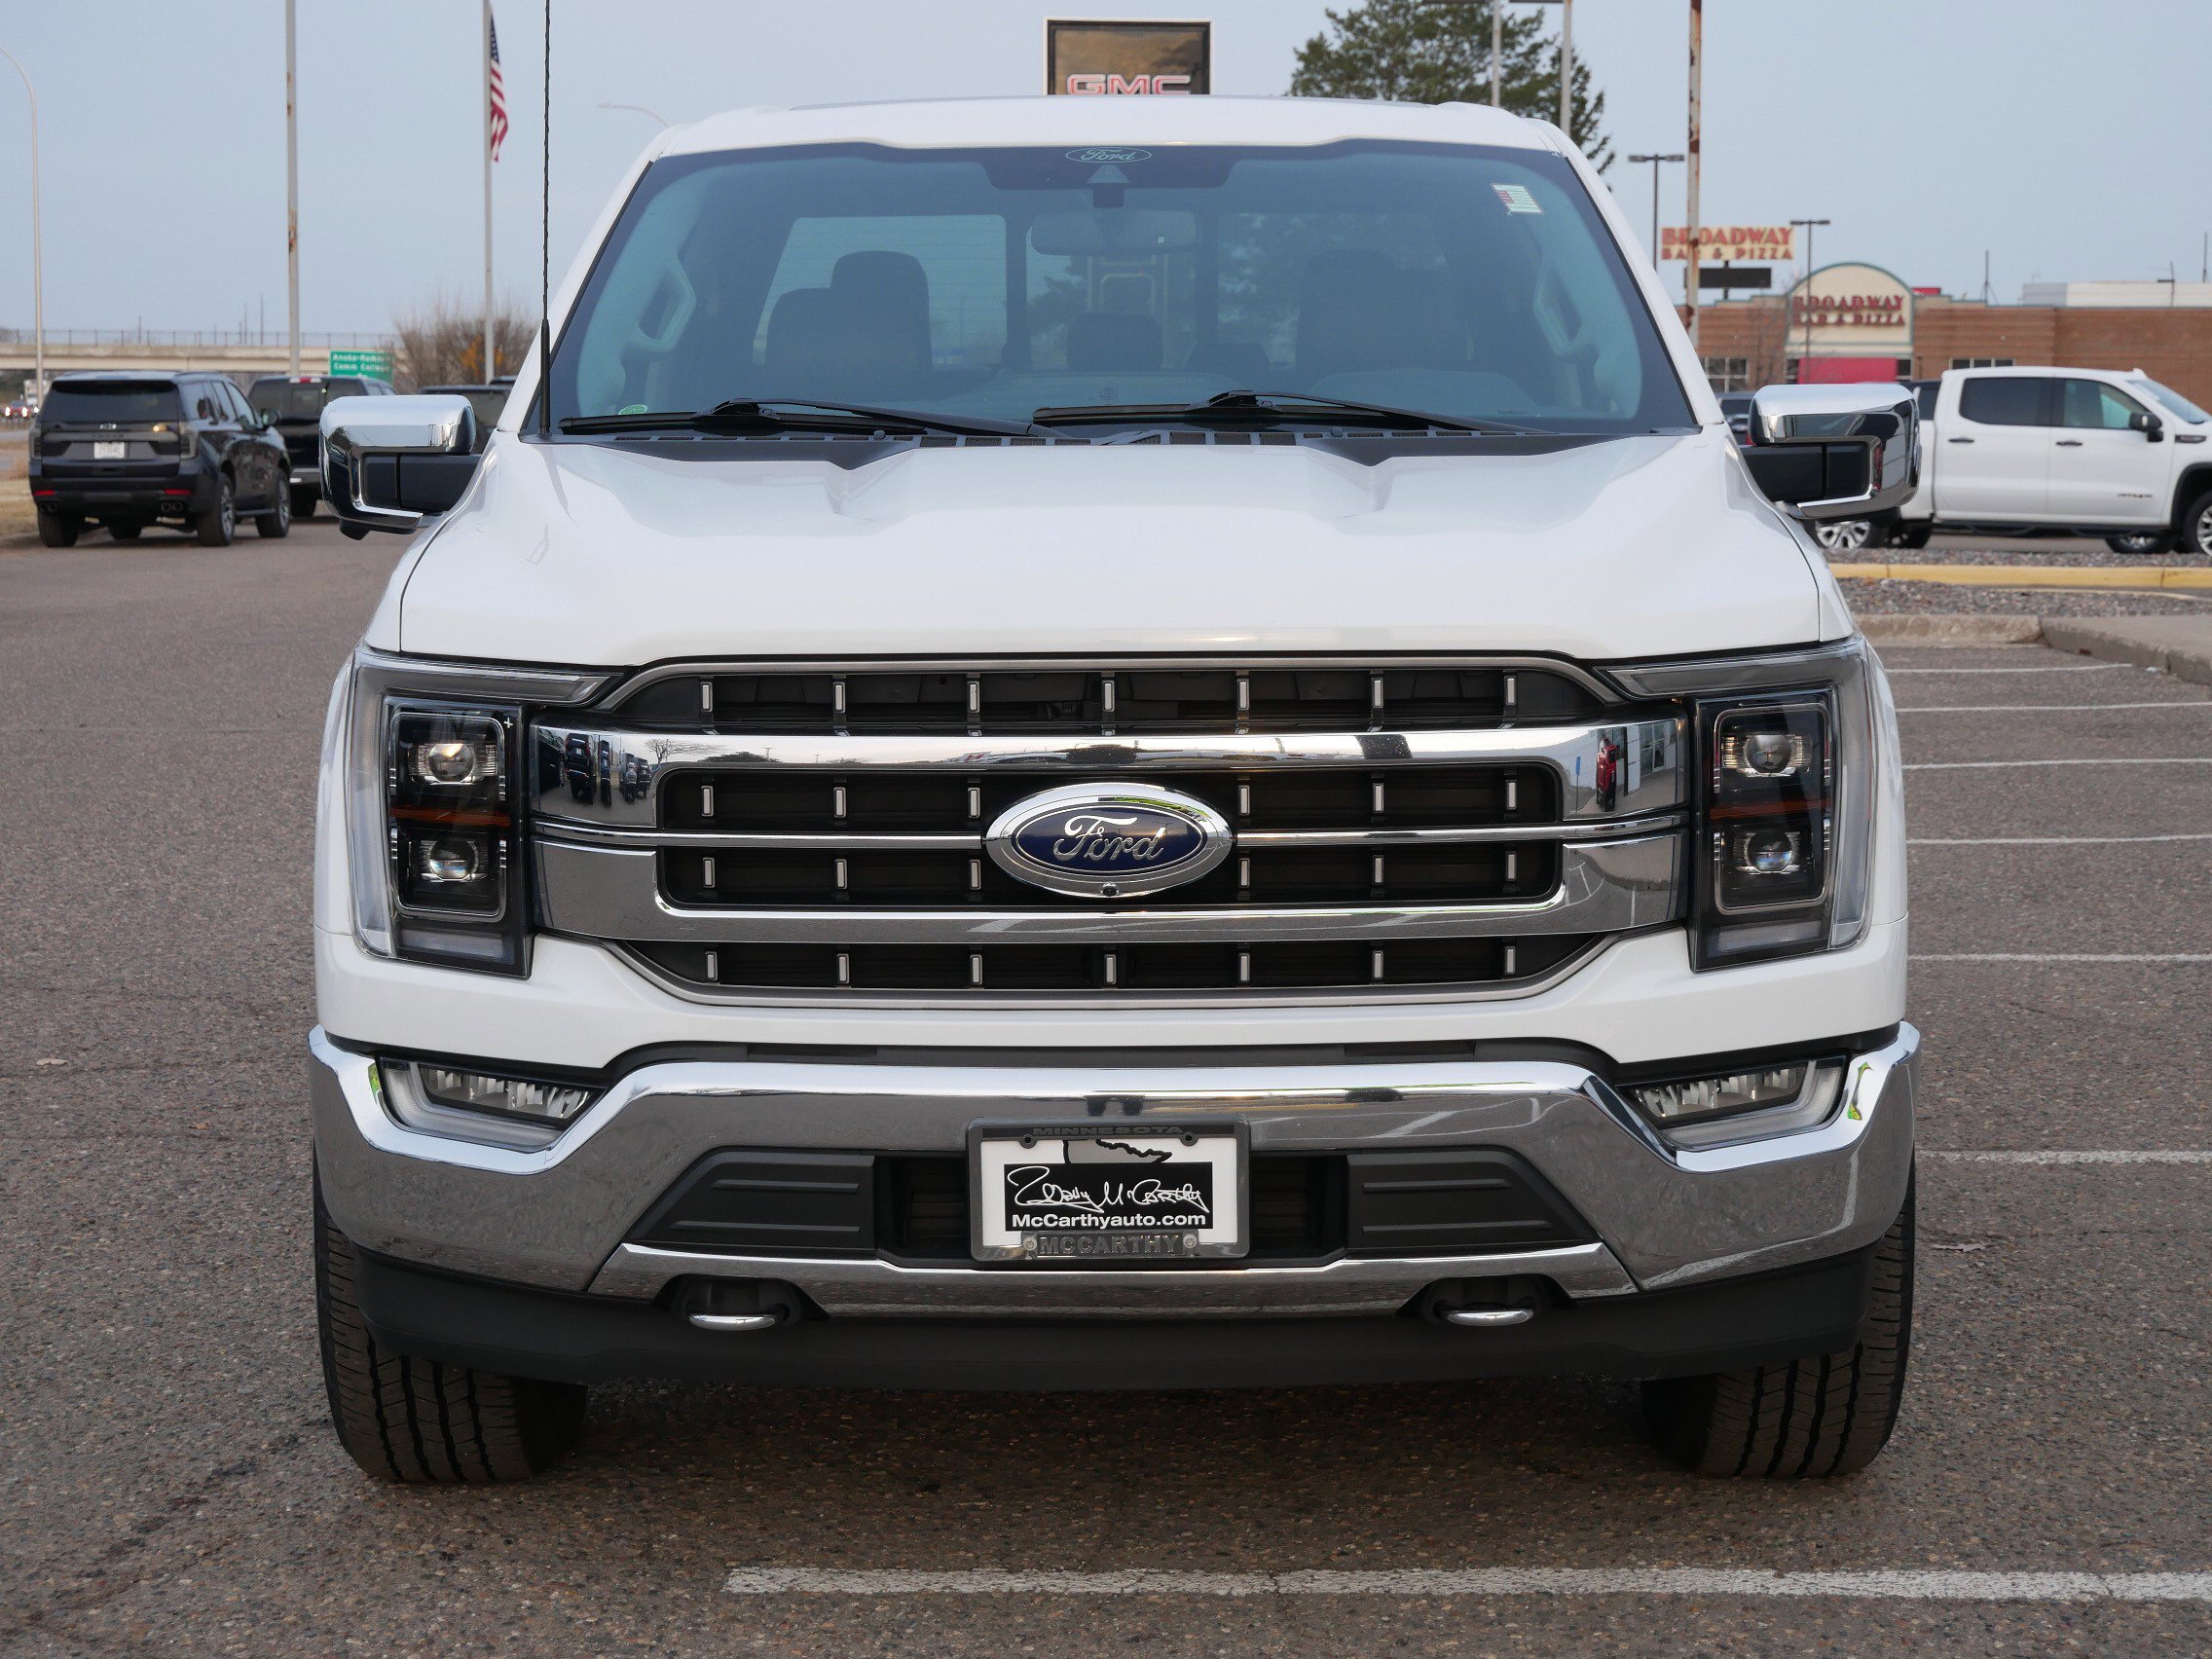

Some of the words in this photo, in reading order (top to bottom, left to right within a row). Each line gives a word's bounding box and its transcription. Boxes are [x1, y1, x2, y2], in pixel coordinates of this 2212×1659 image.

[1067, 74, 1192, 94] GMC
[1080, 148, 1137, 161] Ford
[1661, 247, 1700, 260] BA
[1735, 247, 1793, 260] PIZZA
[1792, 295, 1903, 311] BROADWAY
[1853, 313, 1905, 326] PIZZA
[1052, 815, 1164, 861] Ford
[1033, 1126, 1184, 1135] MINNESOTA
[1012, 1213, 1207, 1230] McCarthyauto.com
[1039, 1235, 1180, 1255] MCCARTHY
